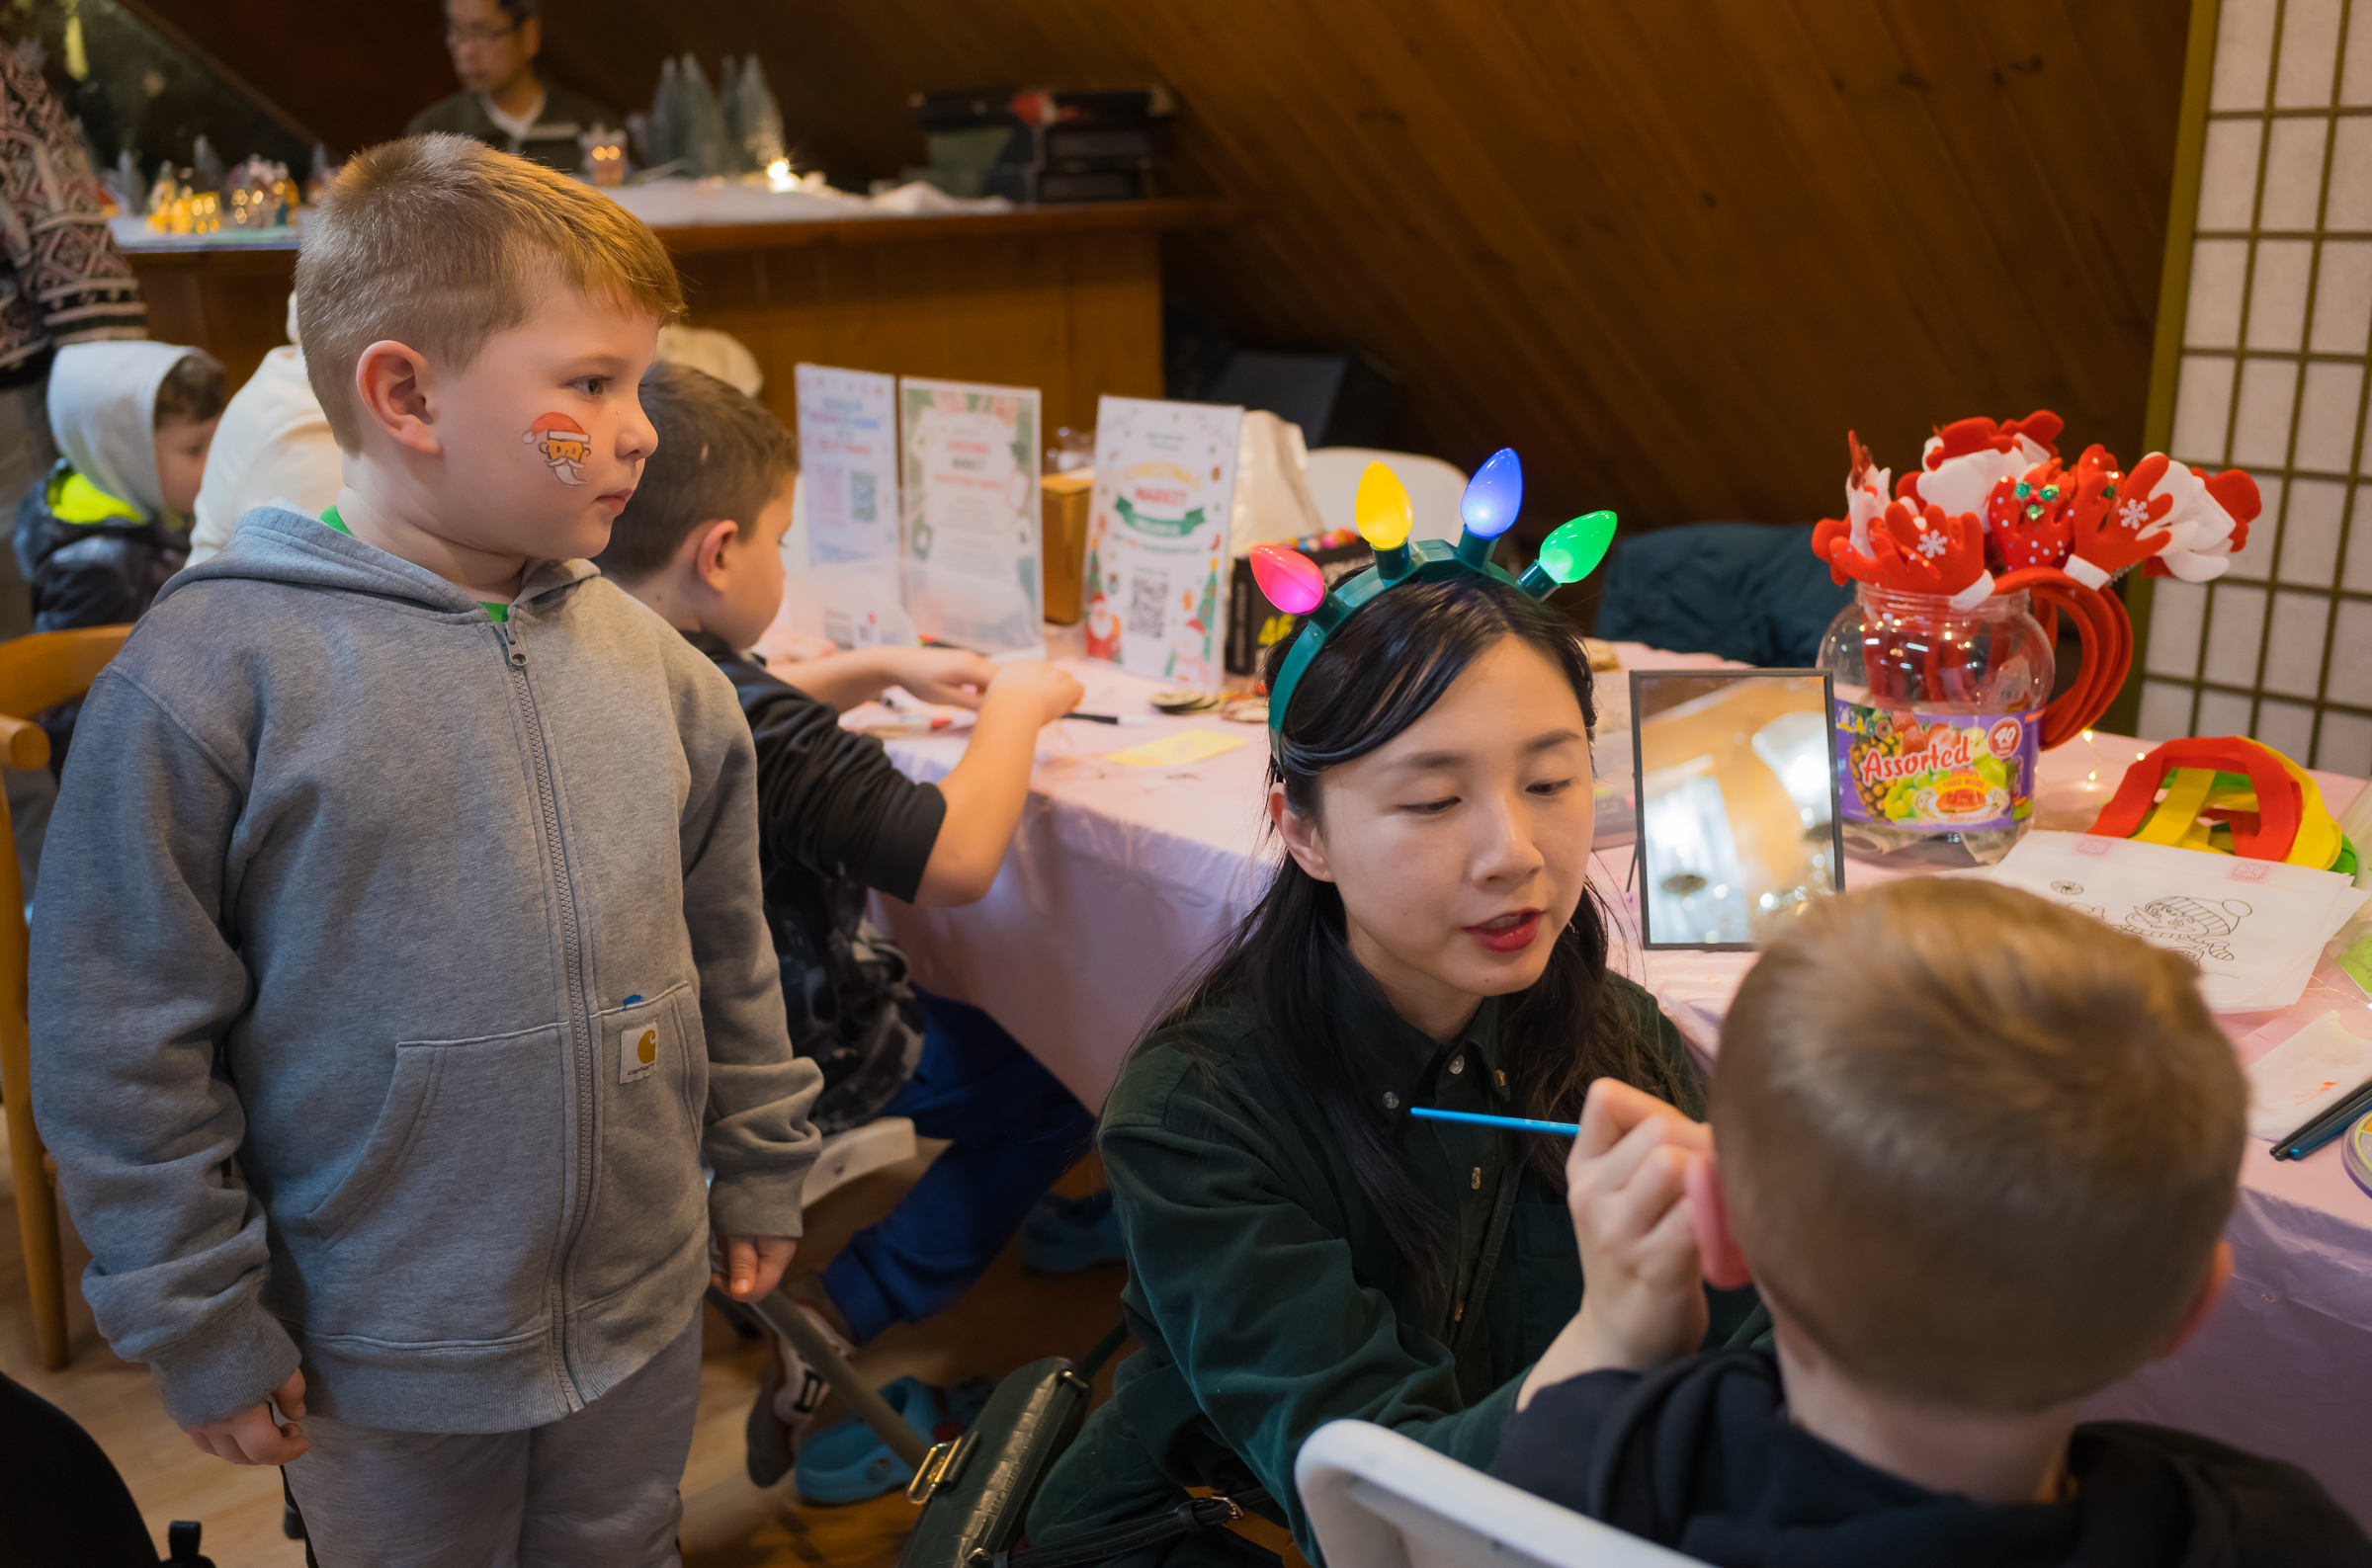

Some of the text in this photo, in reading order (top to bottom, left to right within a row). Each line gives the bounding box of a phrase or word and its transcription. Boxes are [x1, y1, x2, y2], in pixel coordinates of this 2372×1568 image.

[1854, 716, 1892, 739] ABC
[1994, 726, 2017, 743] 40
[1862, 735, 1972, 784] Assorted
